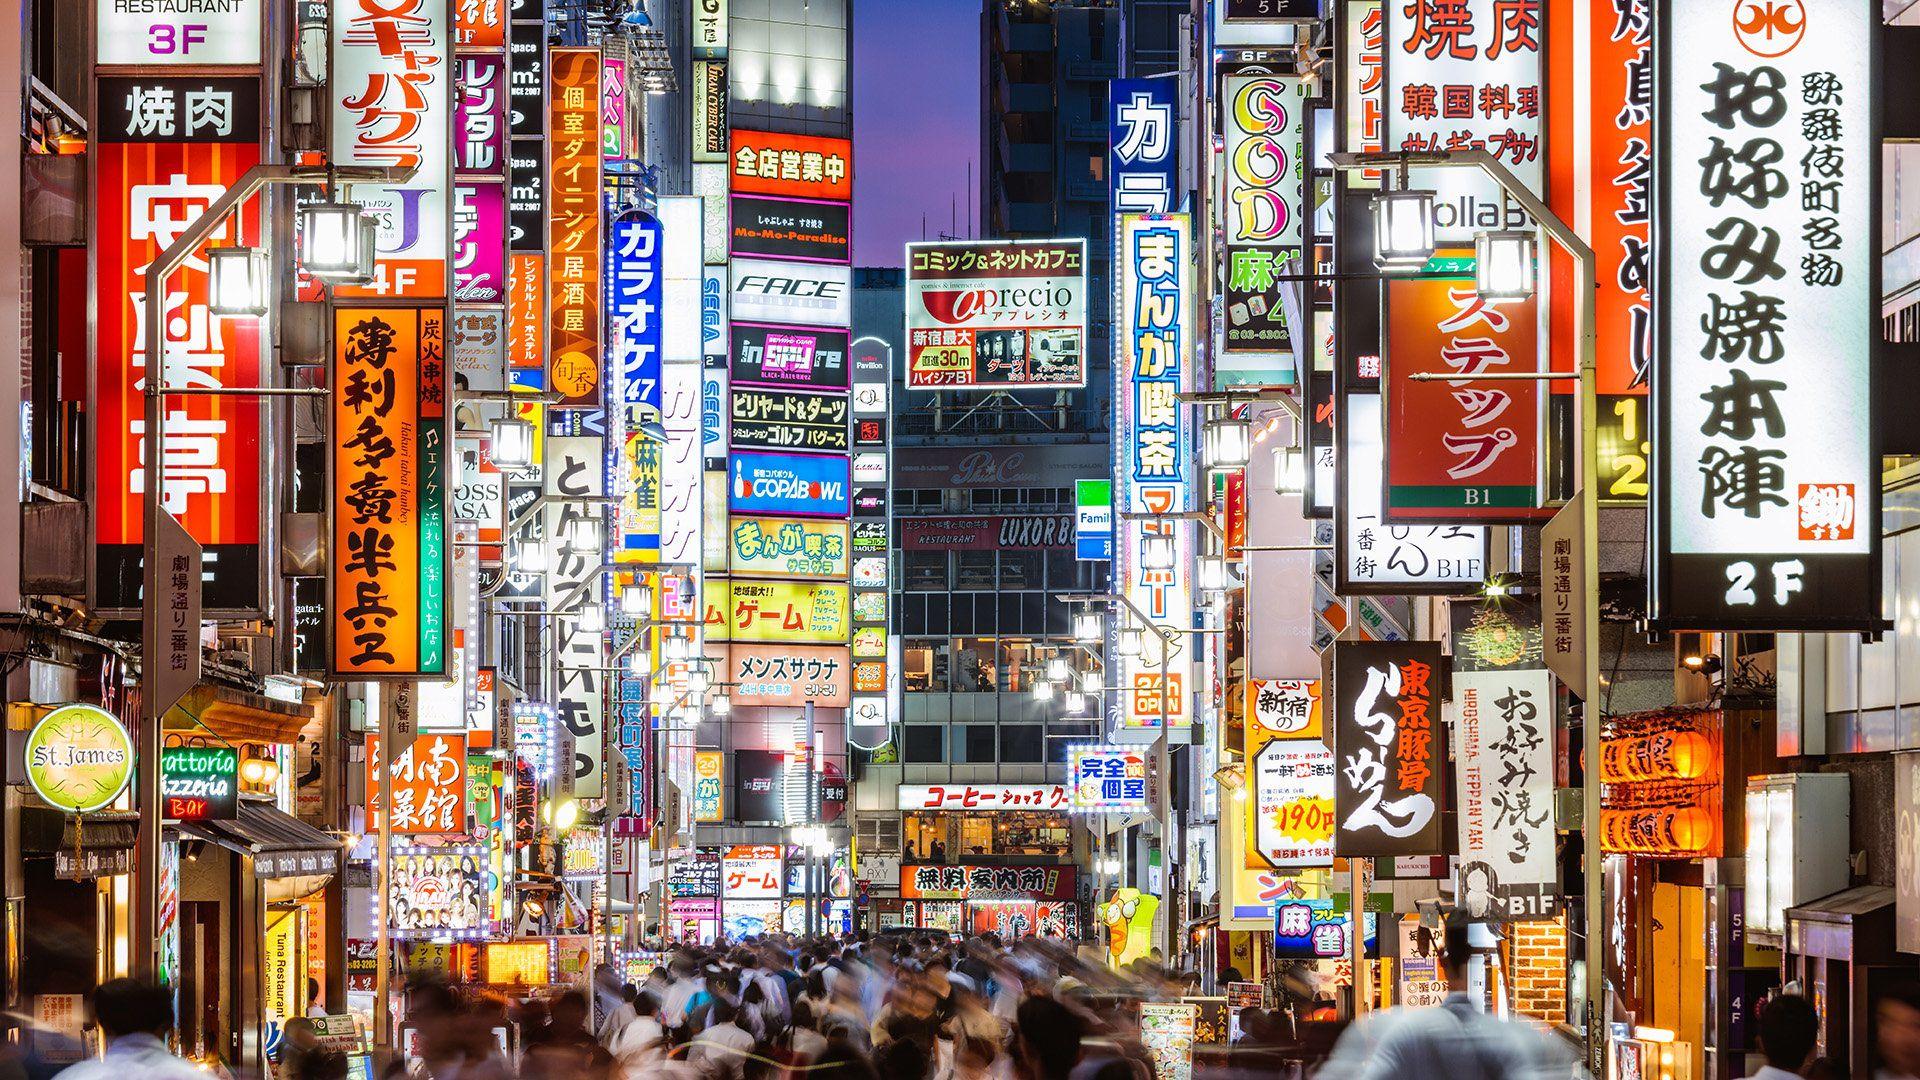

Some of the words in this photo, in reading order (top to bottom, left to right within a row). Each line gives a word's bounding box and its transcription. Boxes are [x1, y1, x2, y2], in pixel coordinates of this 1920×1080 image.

[115, 0, 243, 13] RESTAURANT
[148, 24, 208, 54] 3F
[511, 43, 536, 53] Space
[1241, 51, 1268, 62] 6F
[525, 87, 541, 96] 2007
[708, 66, 725, 94] GRAN
[125, 86, 233, 136] 焼肉
[466, 58, 496, 169] レンタル
[708, 95, 718, 129] CYBER
[708, 130, 718, 151] CAFE
[511, 158, 536, 168] Space
[735, 146, 846, 184] 全店営業中
[1232, 79, 1290, 241] GOD
[1800, 71, 1844, 287] 歌舞伎町名物
[524, 202, 541, 212] 2007
[562, 86, 585, 332] 個室ダイニング居酒屋
[1433, 195, 1538, 228] ollab
[758, 214, 795, 227] しゃぶしゃぶ
[799, 218, 824, 229] すき焼き
[735, 227, 846, 245] Mo-Mo-Paradise
[913, 249, 1080, 272] コミック&ネットカフェ
[362, 264, 417, 295] 4F
[524, 258, 536, 320] レンタルルーム
[735, 275, 846, 299] FACE
[1697, 61, 1790, 519] お好み焼本陣
[618, 223, 656, 373] カラオケ
[703, 277, 721, 343] SEGA
[952, 280, 1073, 321] aprecio
[991, 308, 1070, 321] アプレシオ
[130, 174, 227, 514] 安楽亭
[524, 325, 536, 360] ホステル
[913, 331, 972, 347] 新宿最大
[422, 318, 442, 404] 炭火串焼
[705, 356, 714, 367] 2
[987, 359, 1025, 373] ダーツ
[1136, 233, 1180, 477] まんが喫茶
[1437, 286, 1518, 481] ステップ
[703, 380, 721, 445] SEGA
[733, 393, 847, 424] ビリヤード&ダーツ
[401, 421, 411, 460] Hakuri
[807, 430, 847, 447] バグース
[634, 437, 658, 509] 麻雀
[706, 458, 713, 468] 1
[1463, 487, 1491, 505] B1
[999, 518, 1056, 547] LUXOR
[1079, 513, 1114, 525] Famil
[734, 521, 843, 561] まんが喫茶
[918, 534, 976, 544] RESTAURANT
[1436, 558, 1481, 579] B1F
[1724, 559, 1805, 606] 2F
[423, 563, 440, 645] 楽しいお店
[733, 586, 774, 598] 地域最大!!
[1554, 537, 1572, 654] 劇場通り一番街
[171, 555, 190, 670] 劇場通り一番街
[735, 599, 805, 632] ゲーム
[855, 638, 884, 648] ゲーム
[739, 657, 839, 681] メンズサウナ
[1138, 698, 1180, 713] OPN
[1258, 690, 1310, 718] 新宿
[1276, 717, 1292, 730] の
[1396, 658, 1432, 793] 東京豚骨
[1463, 687, 1479, 762] HIROSHIMA
[1081, 757, 1126, 779] 完全
[1488, 686, 1550, 865] お好み焼き
[924, 787, 996, 808] コーヒー
[1101, 778, 1144, 800] 個室
[171, 798, 207, 817] Bar
[1465, 766, 1484, 851] TEPPANYAKI
[727, 871, 779, 890] ゲーム
[915, 867, 1045, 891] 無料案内所
[1313, 909, 1344, 921] フリー
[1508, 895, 1554, 915] B1F
[277, 932, 287, 960] Tuna
[277, 963, 287, 1018] Restaurant
